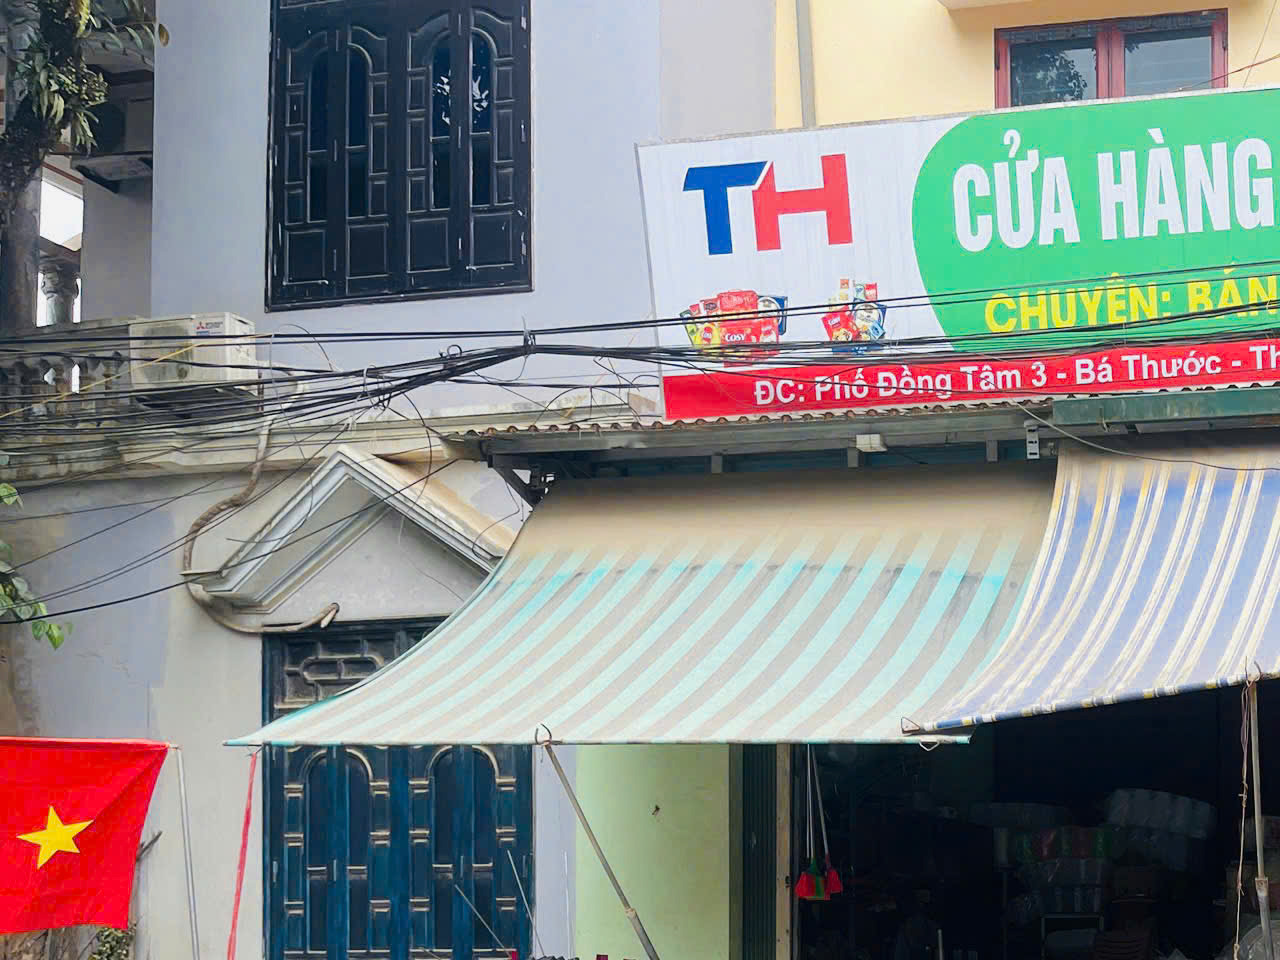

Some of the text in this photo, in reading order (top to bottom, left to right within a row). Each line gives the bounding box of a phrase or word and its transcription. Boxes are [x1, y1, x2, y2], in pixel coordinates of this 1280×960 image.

[683, 153, 853, 255] TH
[952, 129, 1080, 253] CỬA
[1097, 128, 1275, 241] HÀNG
[984, 273, 1170, 333] CHUYÊN:
[1186, 262, 1277, 318] BÁN
[754, 379, 805, 406] ĐC:
[814, 367, 869, 402] Phố
[876, 364, 953, 401] Đồng
[960, 363, 1022, 392] Tâm
[1031, 361, 1047, 388] 3
[1075, 354, 1113, 386] Bá
[1121, 349, 1222, 383] Thước
